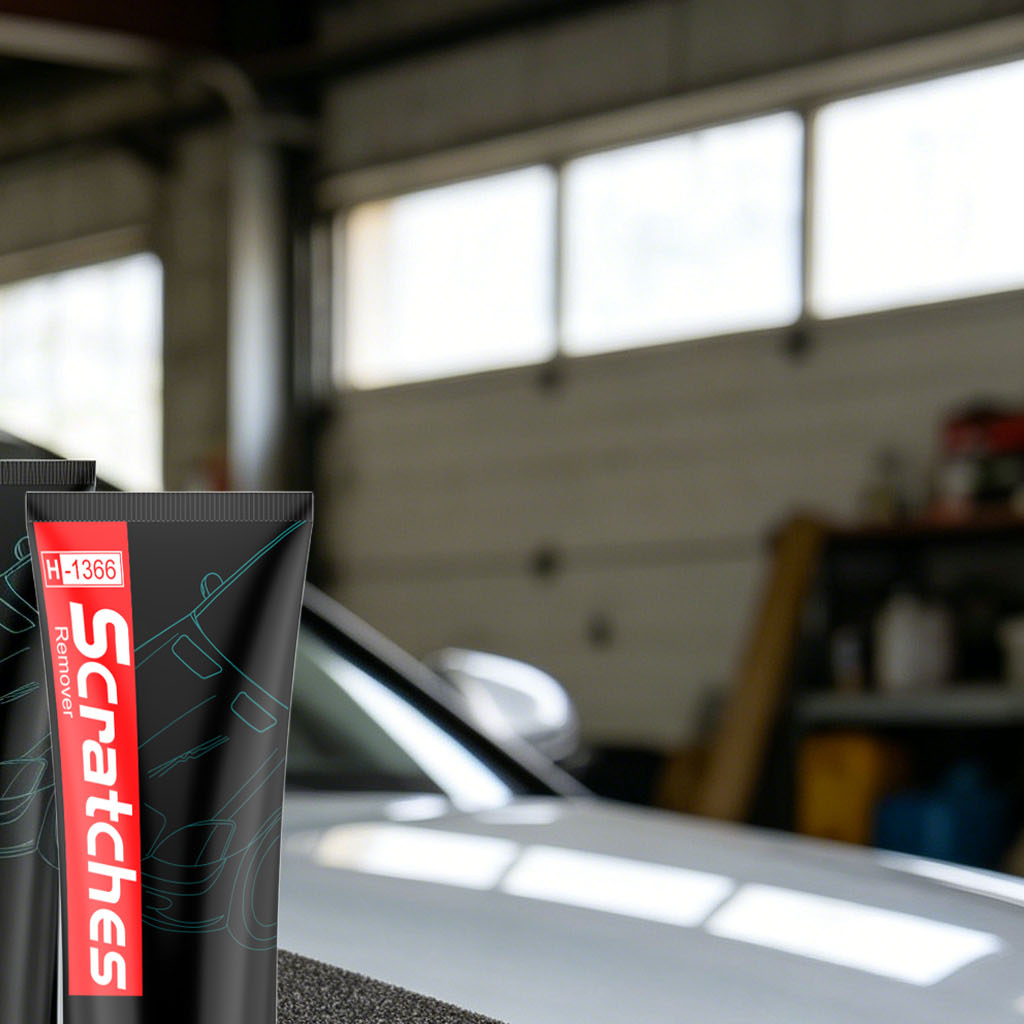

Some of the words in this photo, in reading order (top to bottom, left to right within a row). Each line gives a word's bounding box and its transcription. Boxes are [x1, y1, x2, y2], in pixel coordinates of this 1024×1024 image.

[46, 558, 117, 580] H-1366
[54, 626, 74, 718] Remover
[69, 601, 137, 990] Scratches
